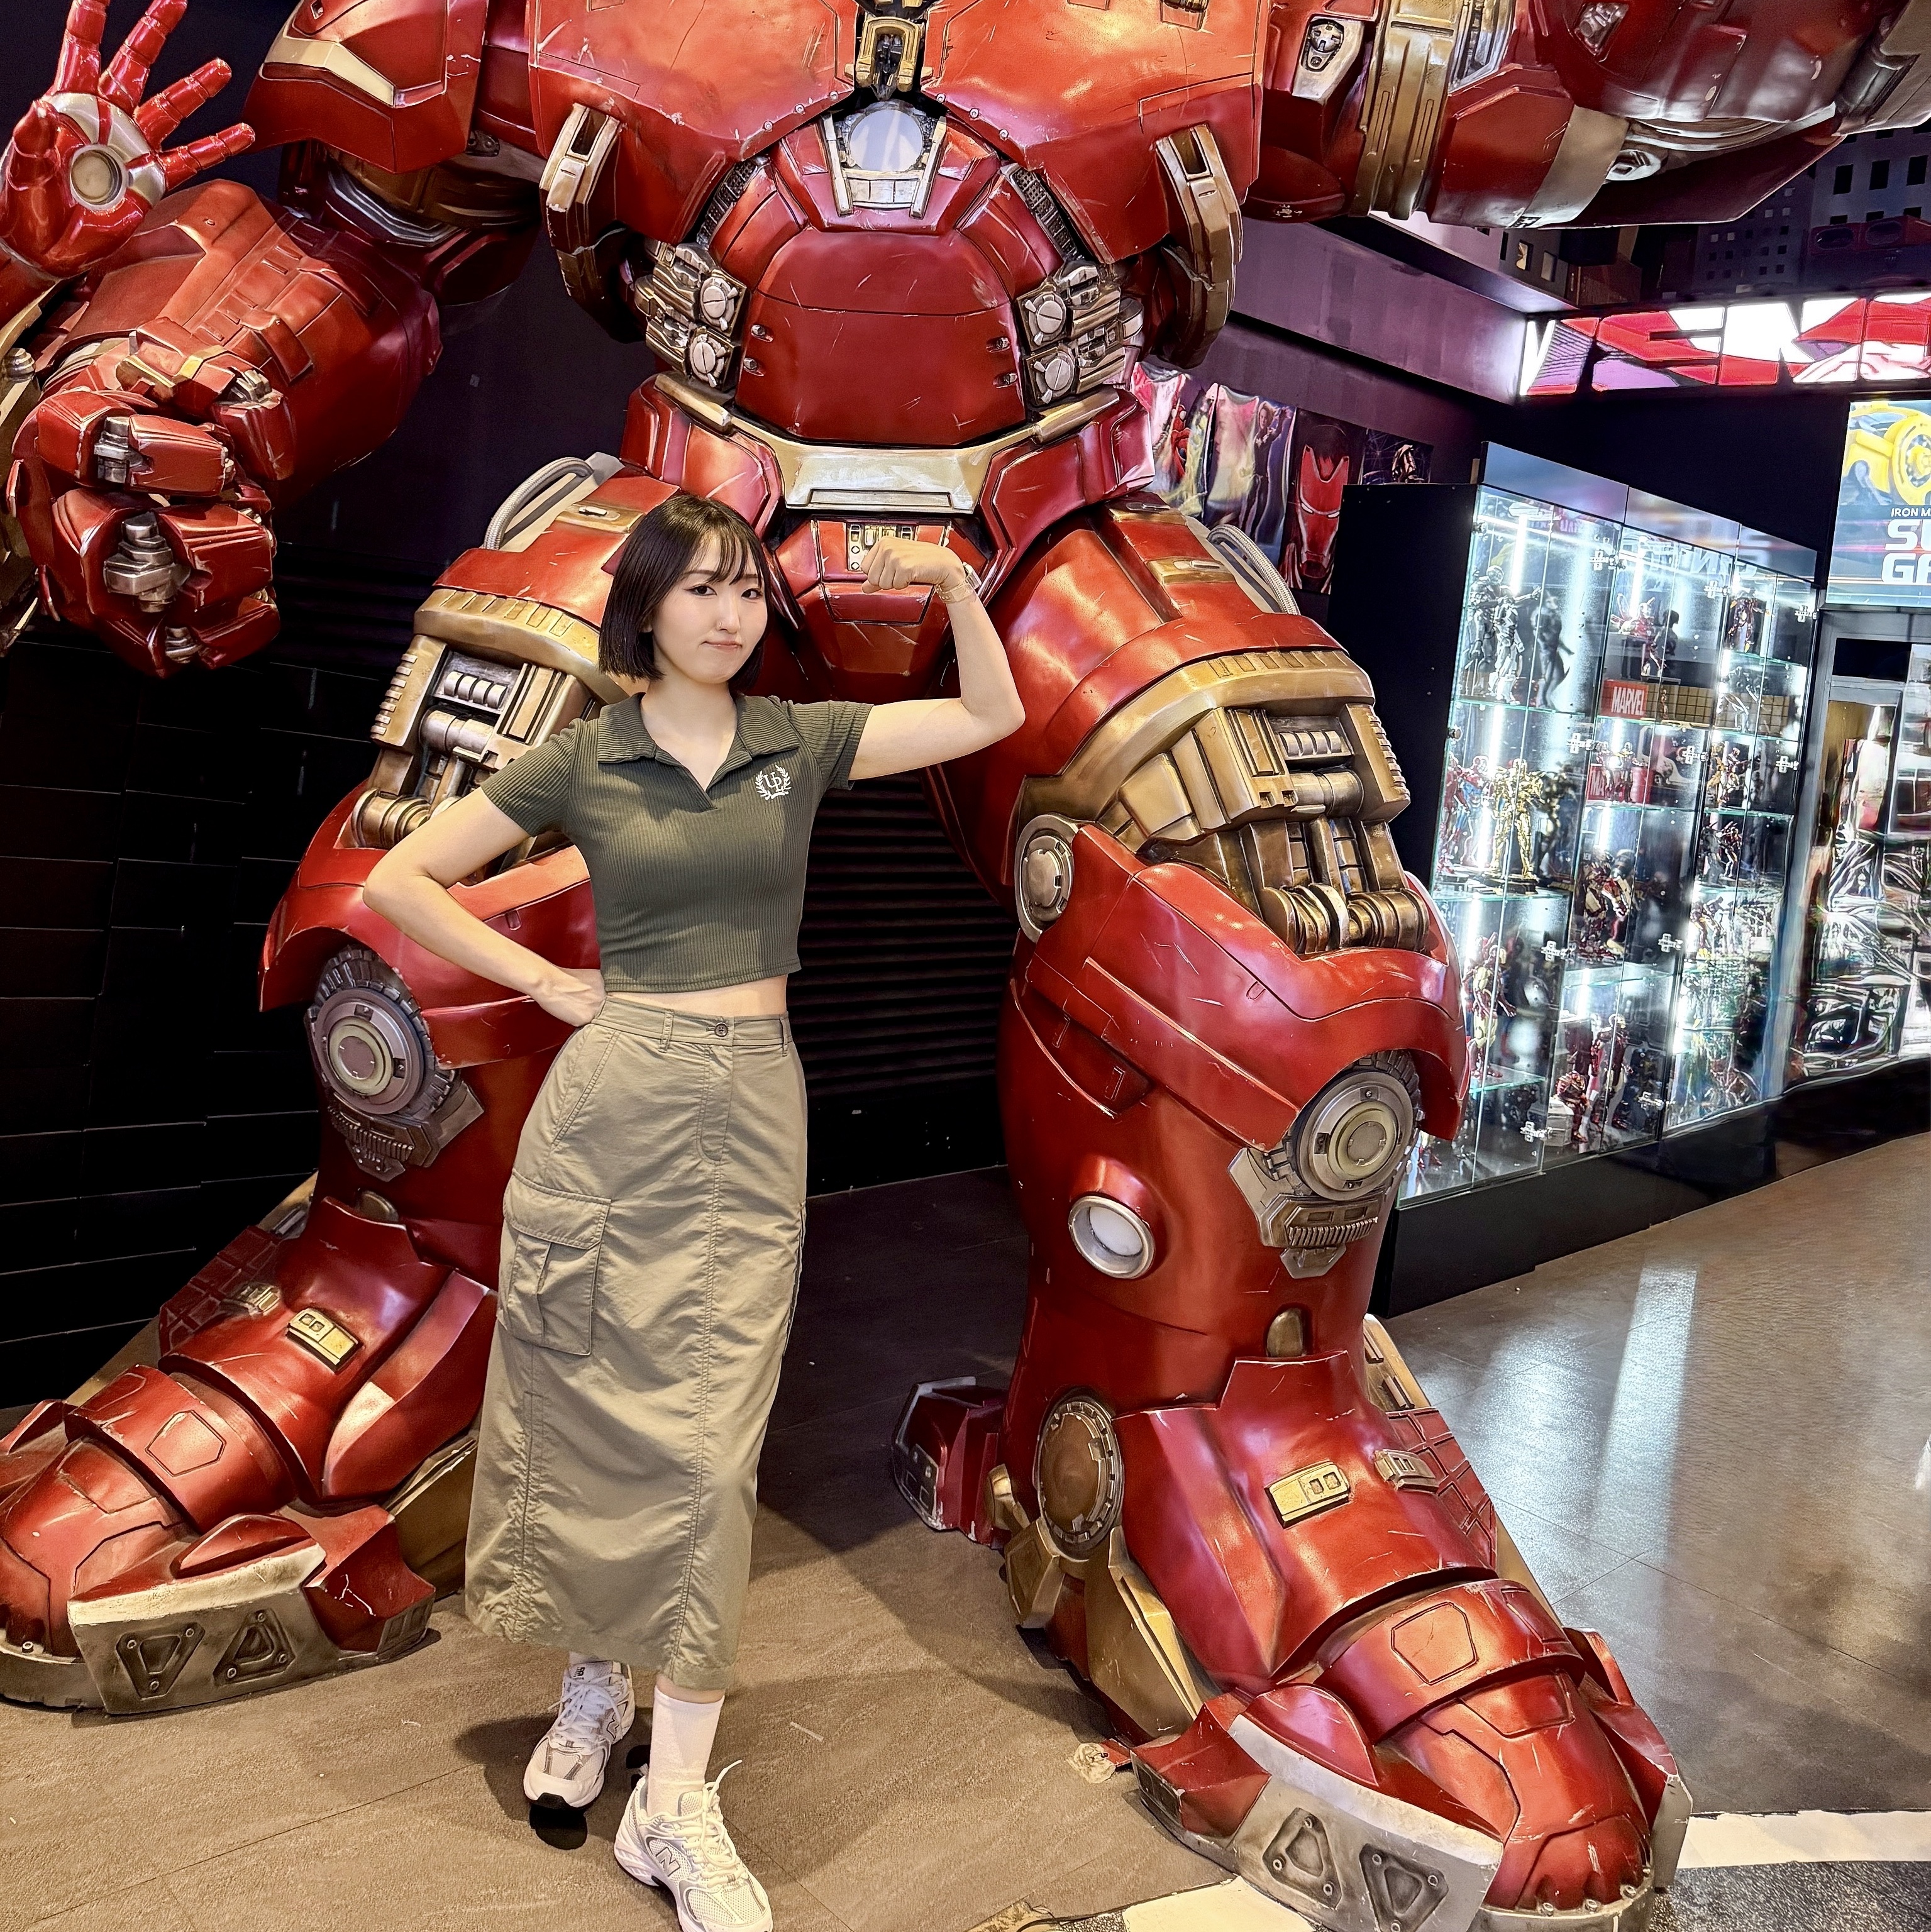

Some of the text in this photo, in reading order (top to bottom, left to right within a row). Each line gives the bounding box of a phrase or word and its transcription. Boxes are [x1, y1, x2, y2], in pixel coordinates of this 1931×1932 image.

[1891, 507, 1931, 517] IRON M
[1611, 686, 1645, 715] MARVEL
